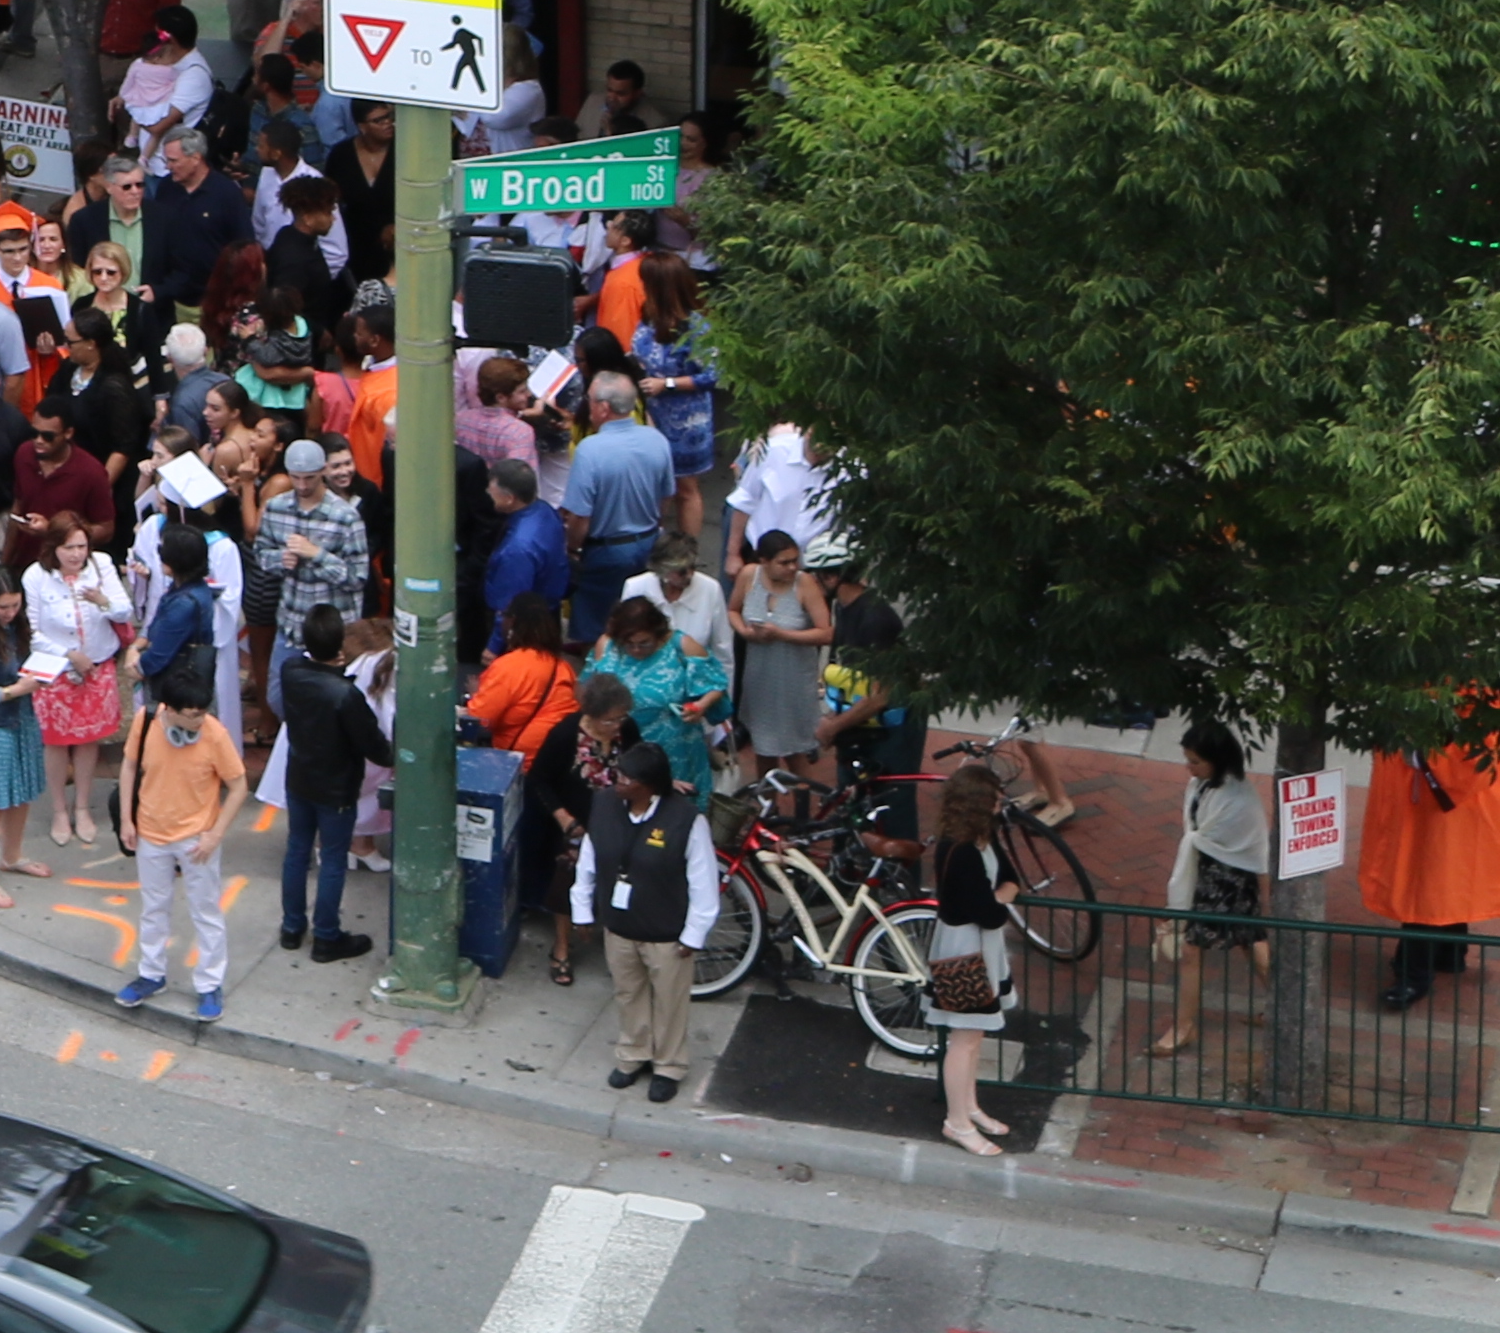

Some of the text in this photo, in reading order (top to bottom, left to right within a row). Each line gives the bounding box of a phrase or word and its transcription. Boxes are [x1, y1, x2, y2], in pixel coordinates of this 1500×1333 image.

[410, 48, 433, 66] TO
[27, 126, 57, 140] BELT
[46, 140, 71, 152] AREA
[654, 137, 671, 155] St
[470, 165, 665, 206] W Broad St
[631, 183, 665, 201] 1100
[1288, 778, 1309, 801] NO
[1291, 795, 1336, 821] PARKING
[1293, 812, 1334, 836] TOWING
[1287, 828, 1339, 854] ENFORCED
